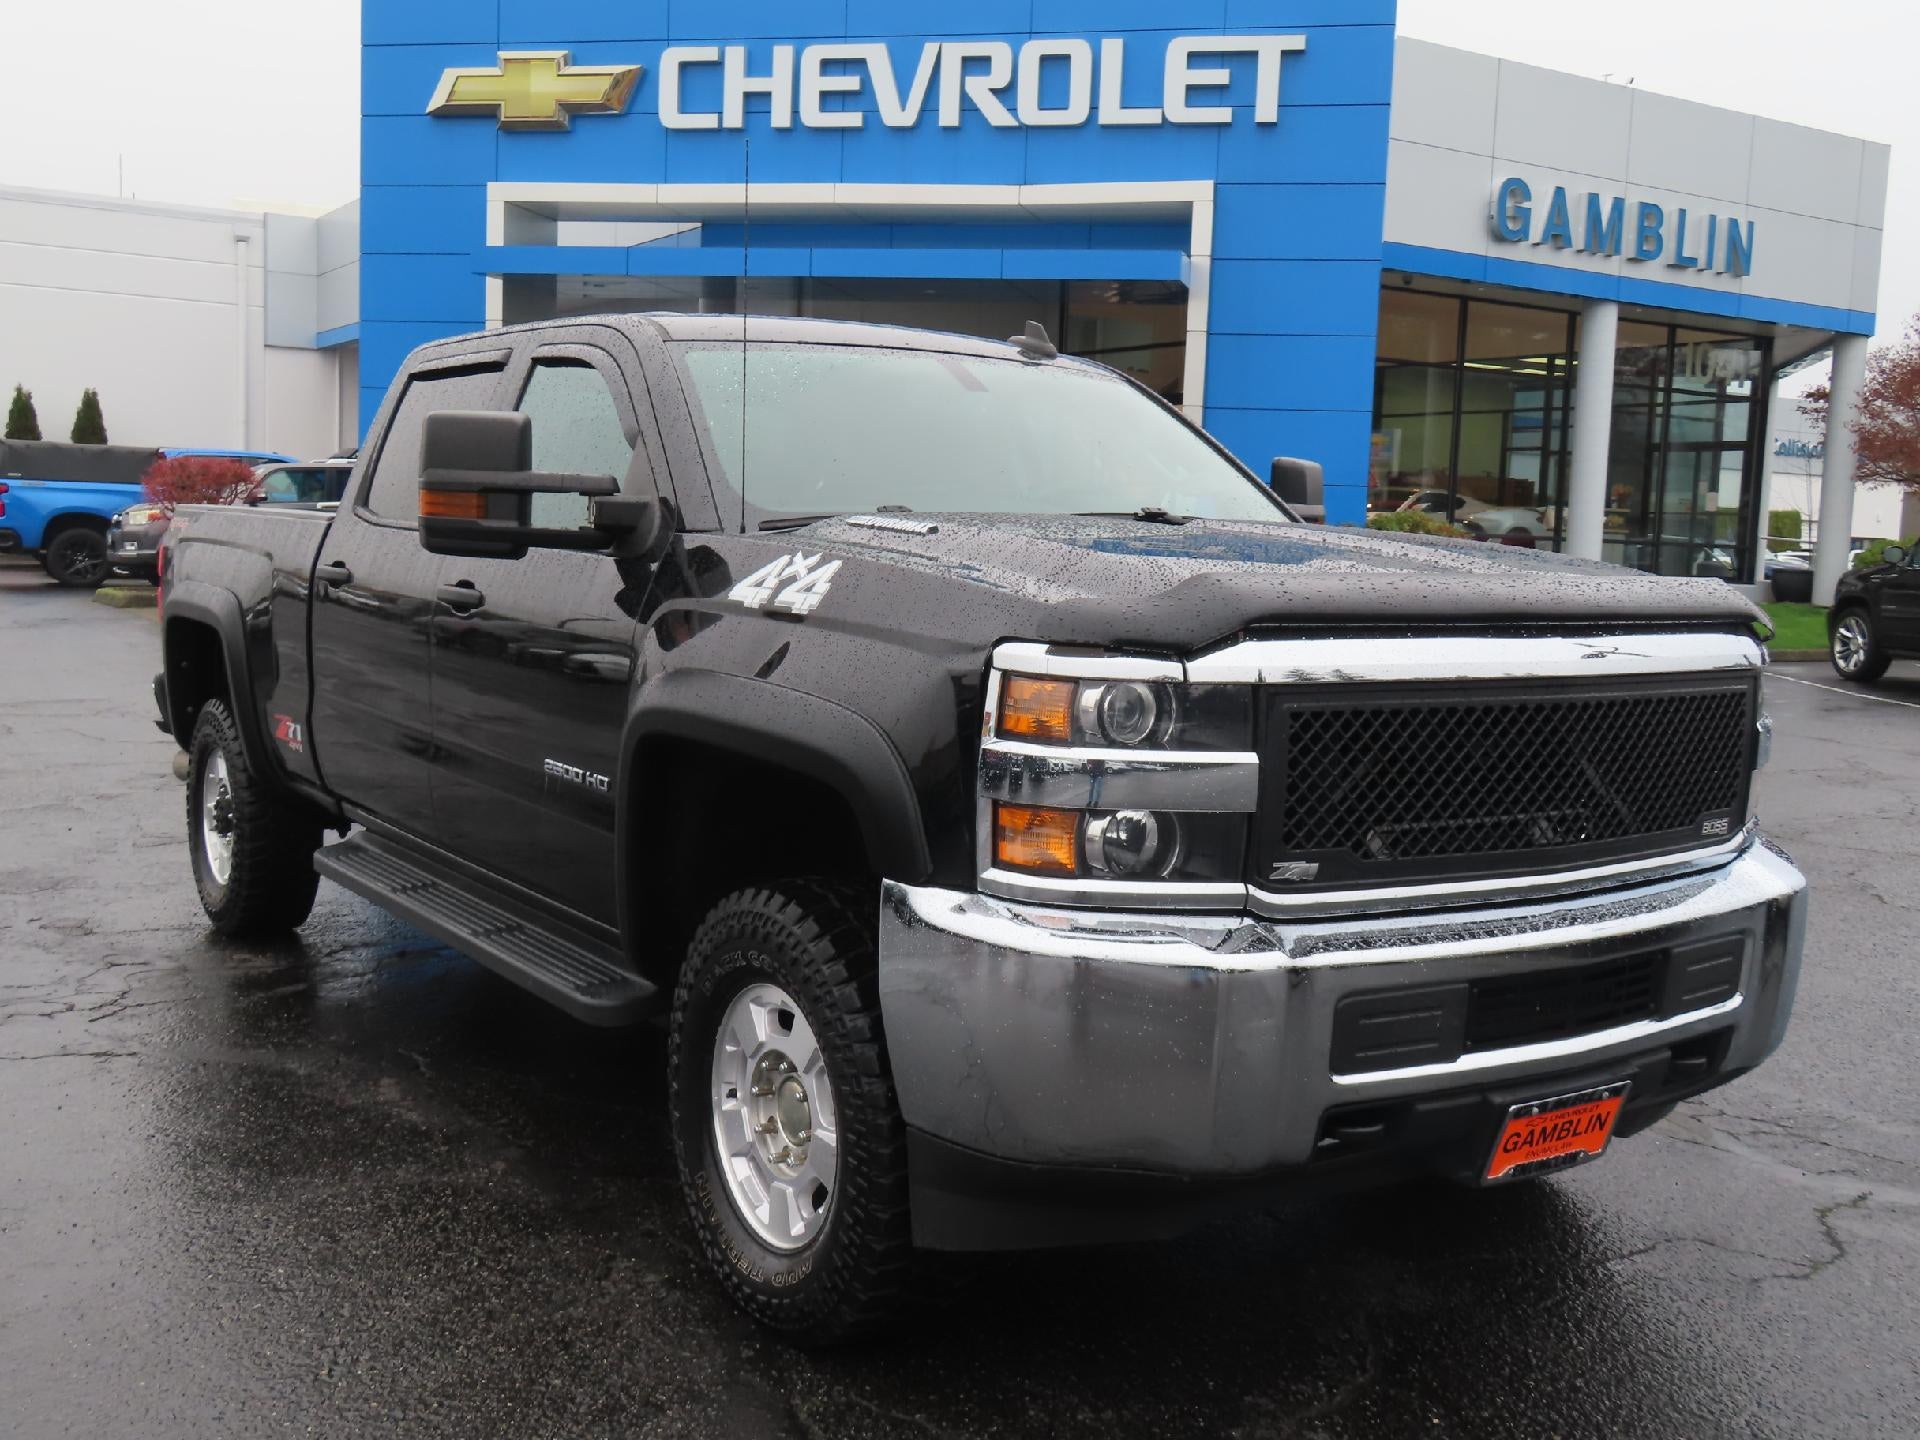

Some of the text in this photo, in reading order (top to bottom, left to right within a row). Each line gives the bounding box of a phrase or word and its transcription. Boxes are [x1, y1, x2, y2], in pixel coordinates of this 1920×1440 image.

[658, 34, 1306, 130] CHEVROLET
[1495, 176, 1755, 277] GAMBLIN
[272, 712, 302, 741] Z71
[585, 771, 609, 791] HD
[1503, 1111, 1611, 1153] GAMBLIN
